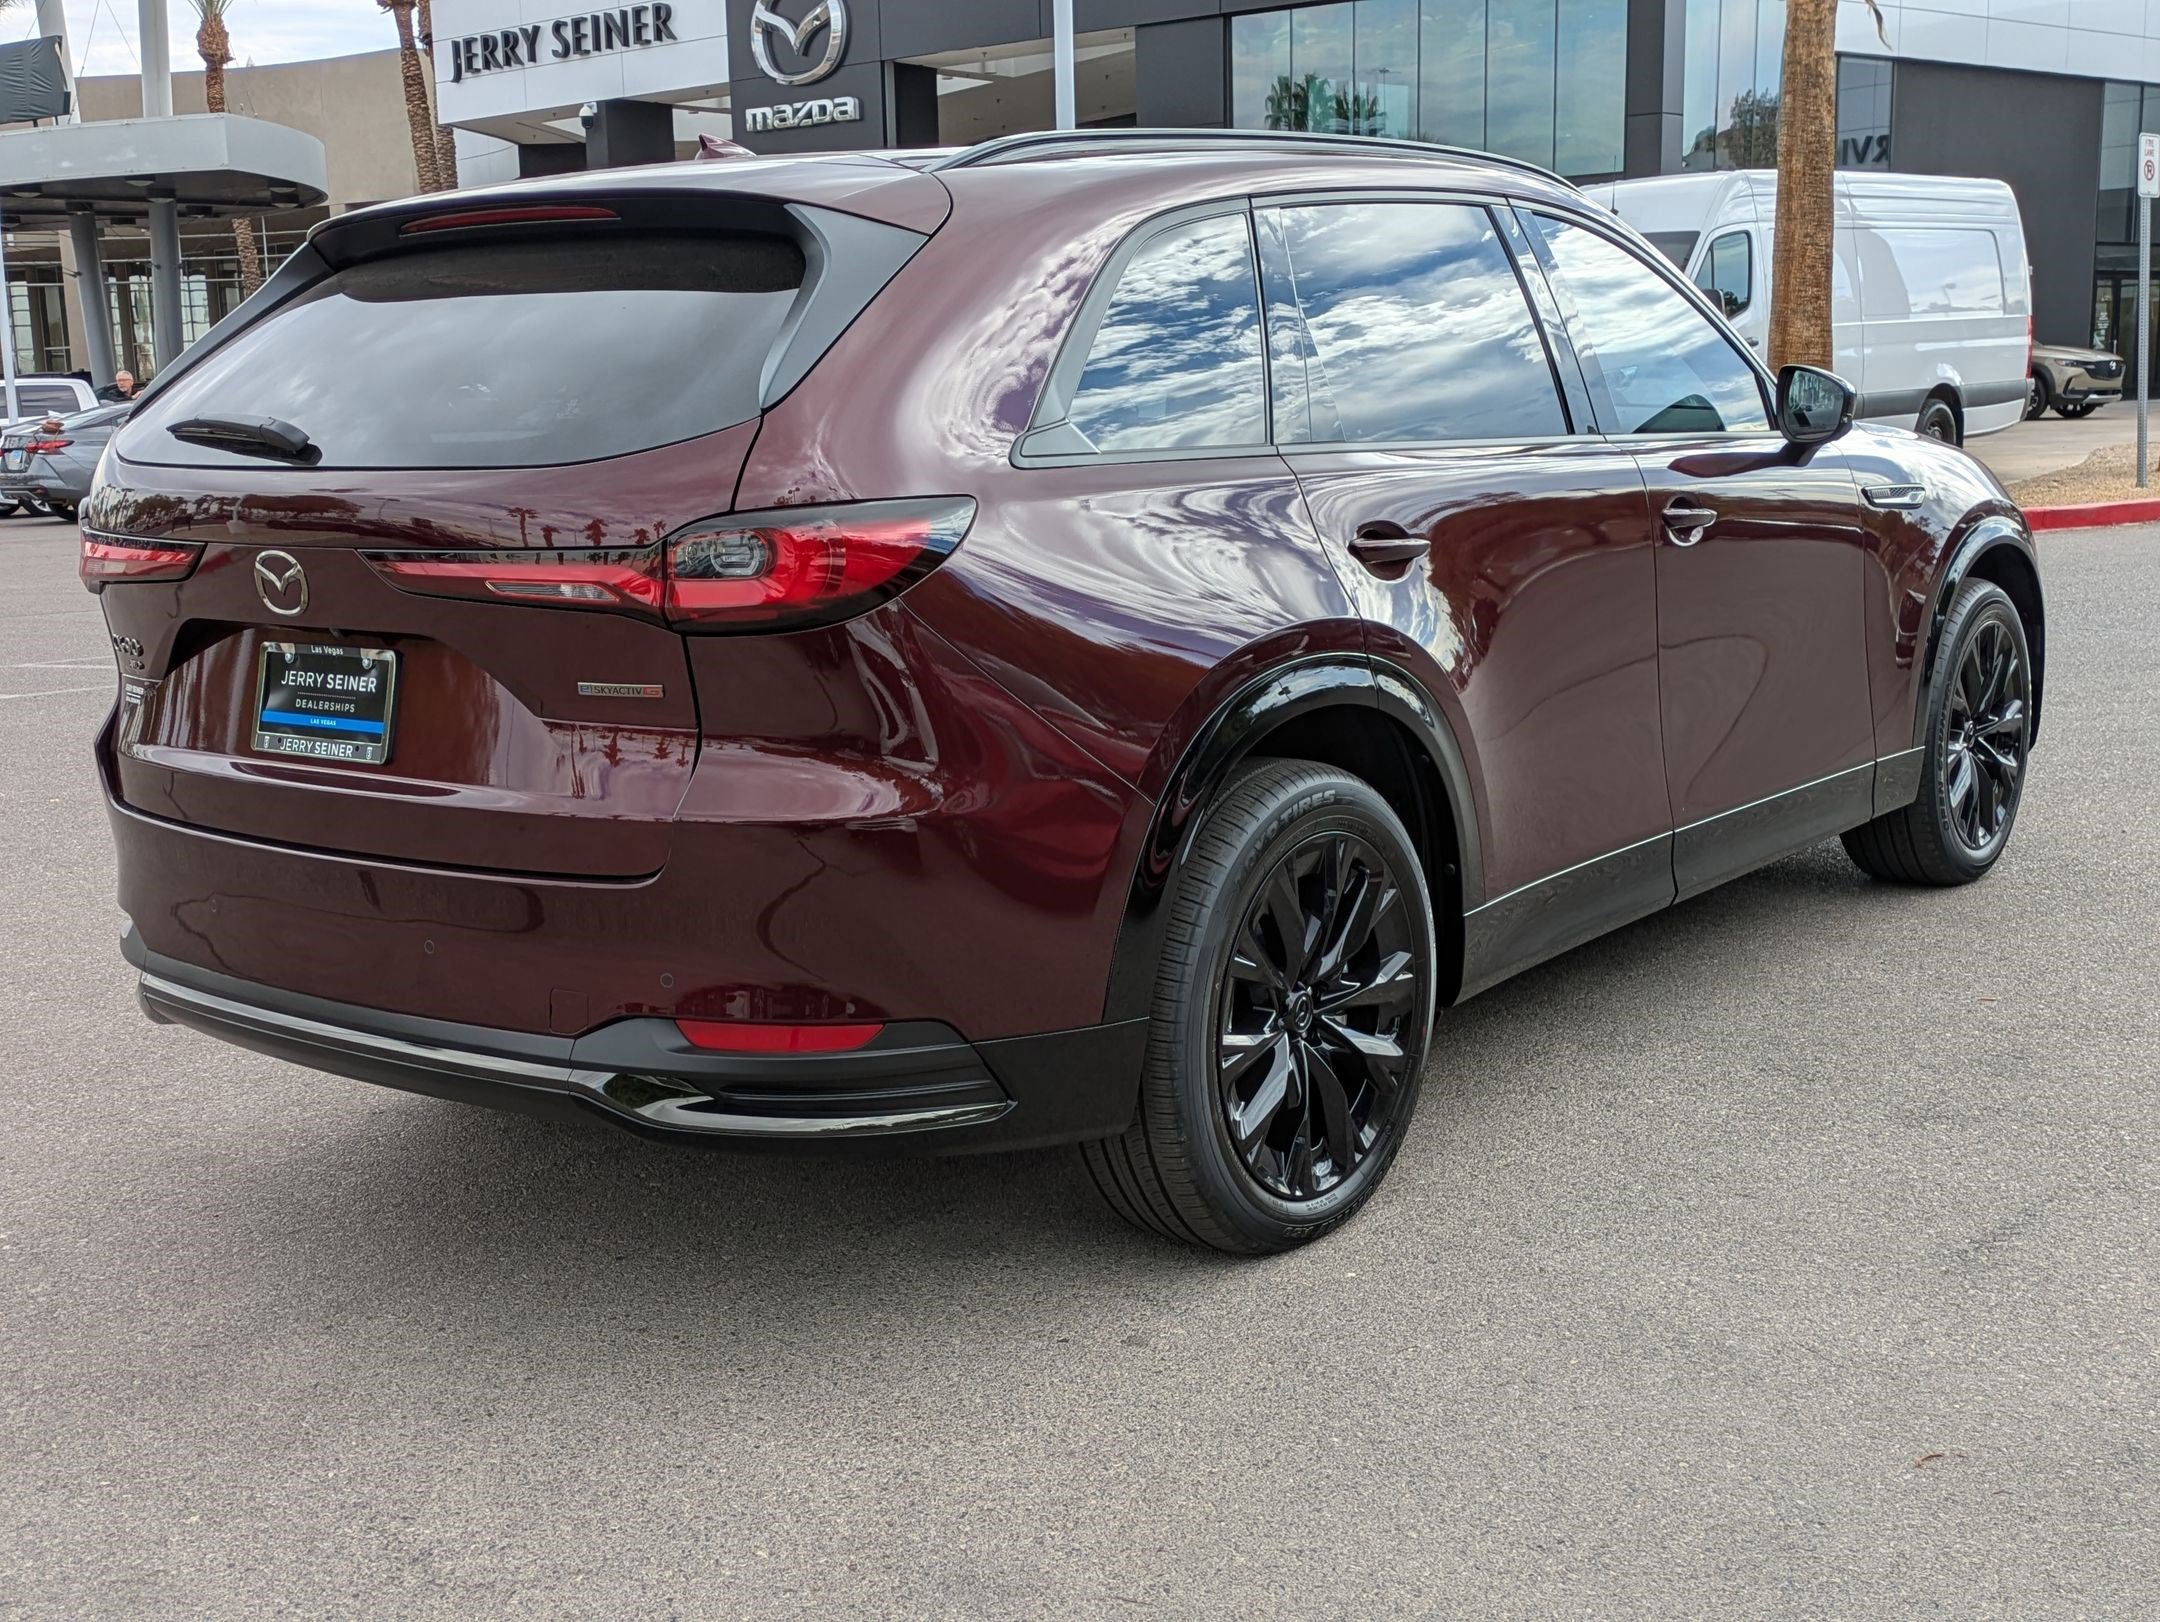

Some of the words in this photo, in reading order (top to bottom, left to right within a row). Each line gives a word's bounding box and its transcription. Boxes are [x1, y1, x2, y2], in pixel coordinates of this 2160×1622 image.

[451, 25, 541, 83] JERRY
[551, 2, 678, 59] SEINER
[745, 96, 863, 132] mazda
[311, 645, 323, 654] Las
[323, 645, 344, 656] Vegas
[281, 670, 325, 688] JERRY
[326, 673, 377, 693] SEINER
[594, 685, 642, 695] SKYACTIV
[295, 698, 355, 713] DEALERSHIPS
[320, 719, 337, 727] VEGAS
[280, 738, 314, 751] JERRY
[314, 741, 353, 758] SEINER
[1280, 789, 1336, 823] TIRES
